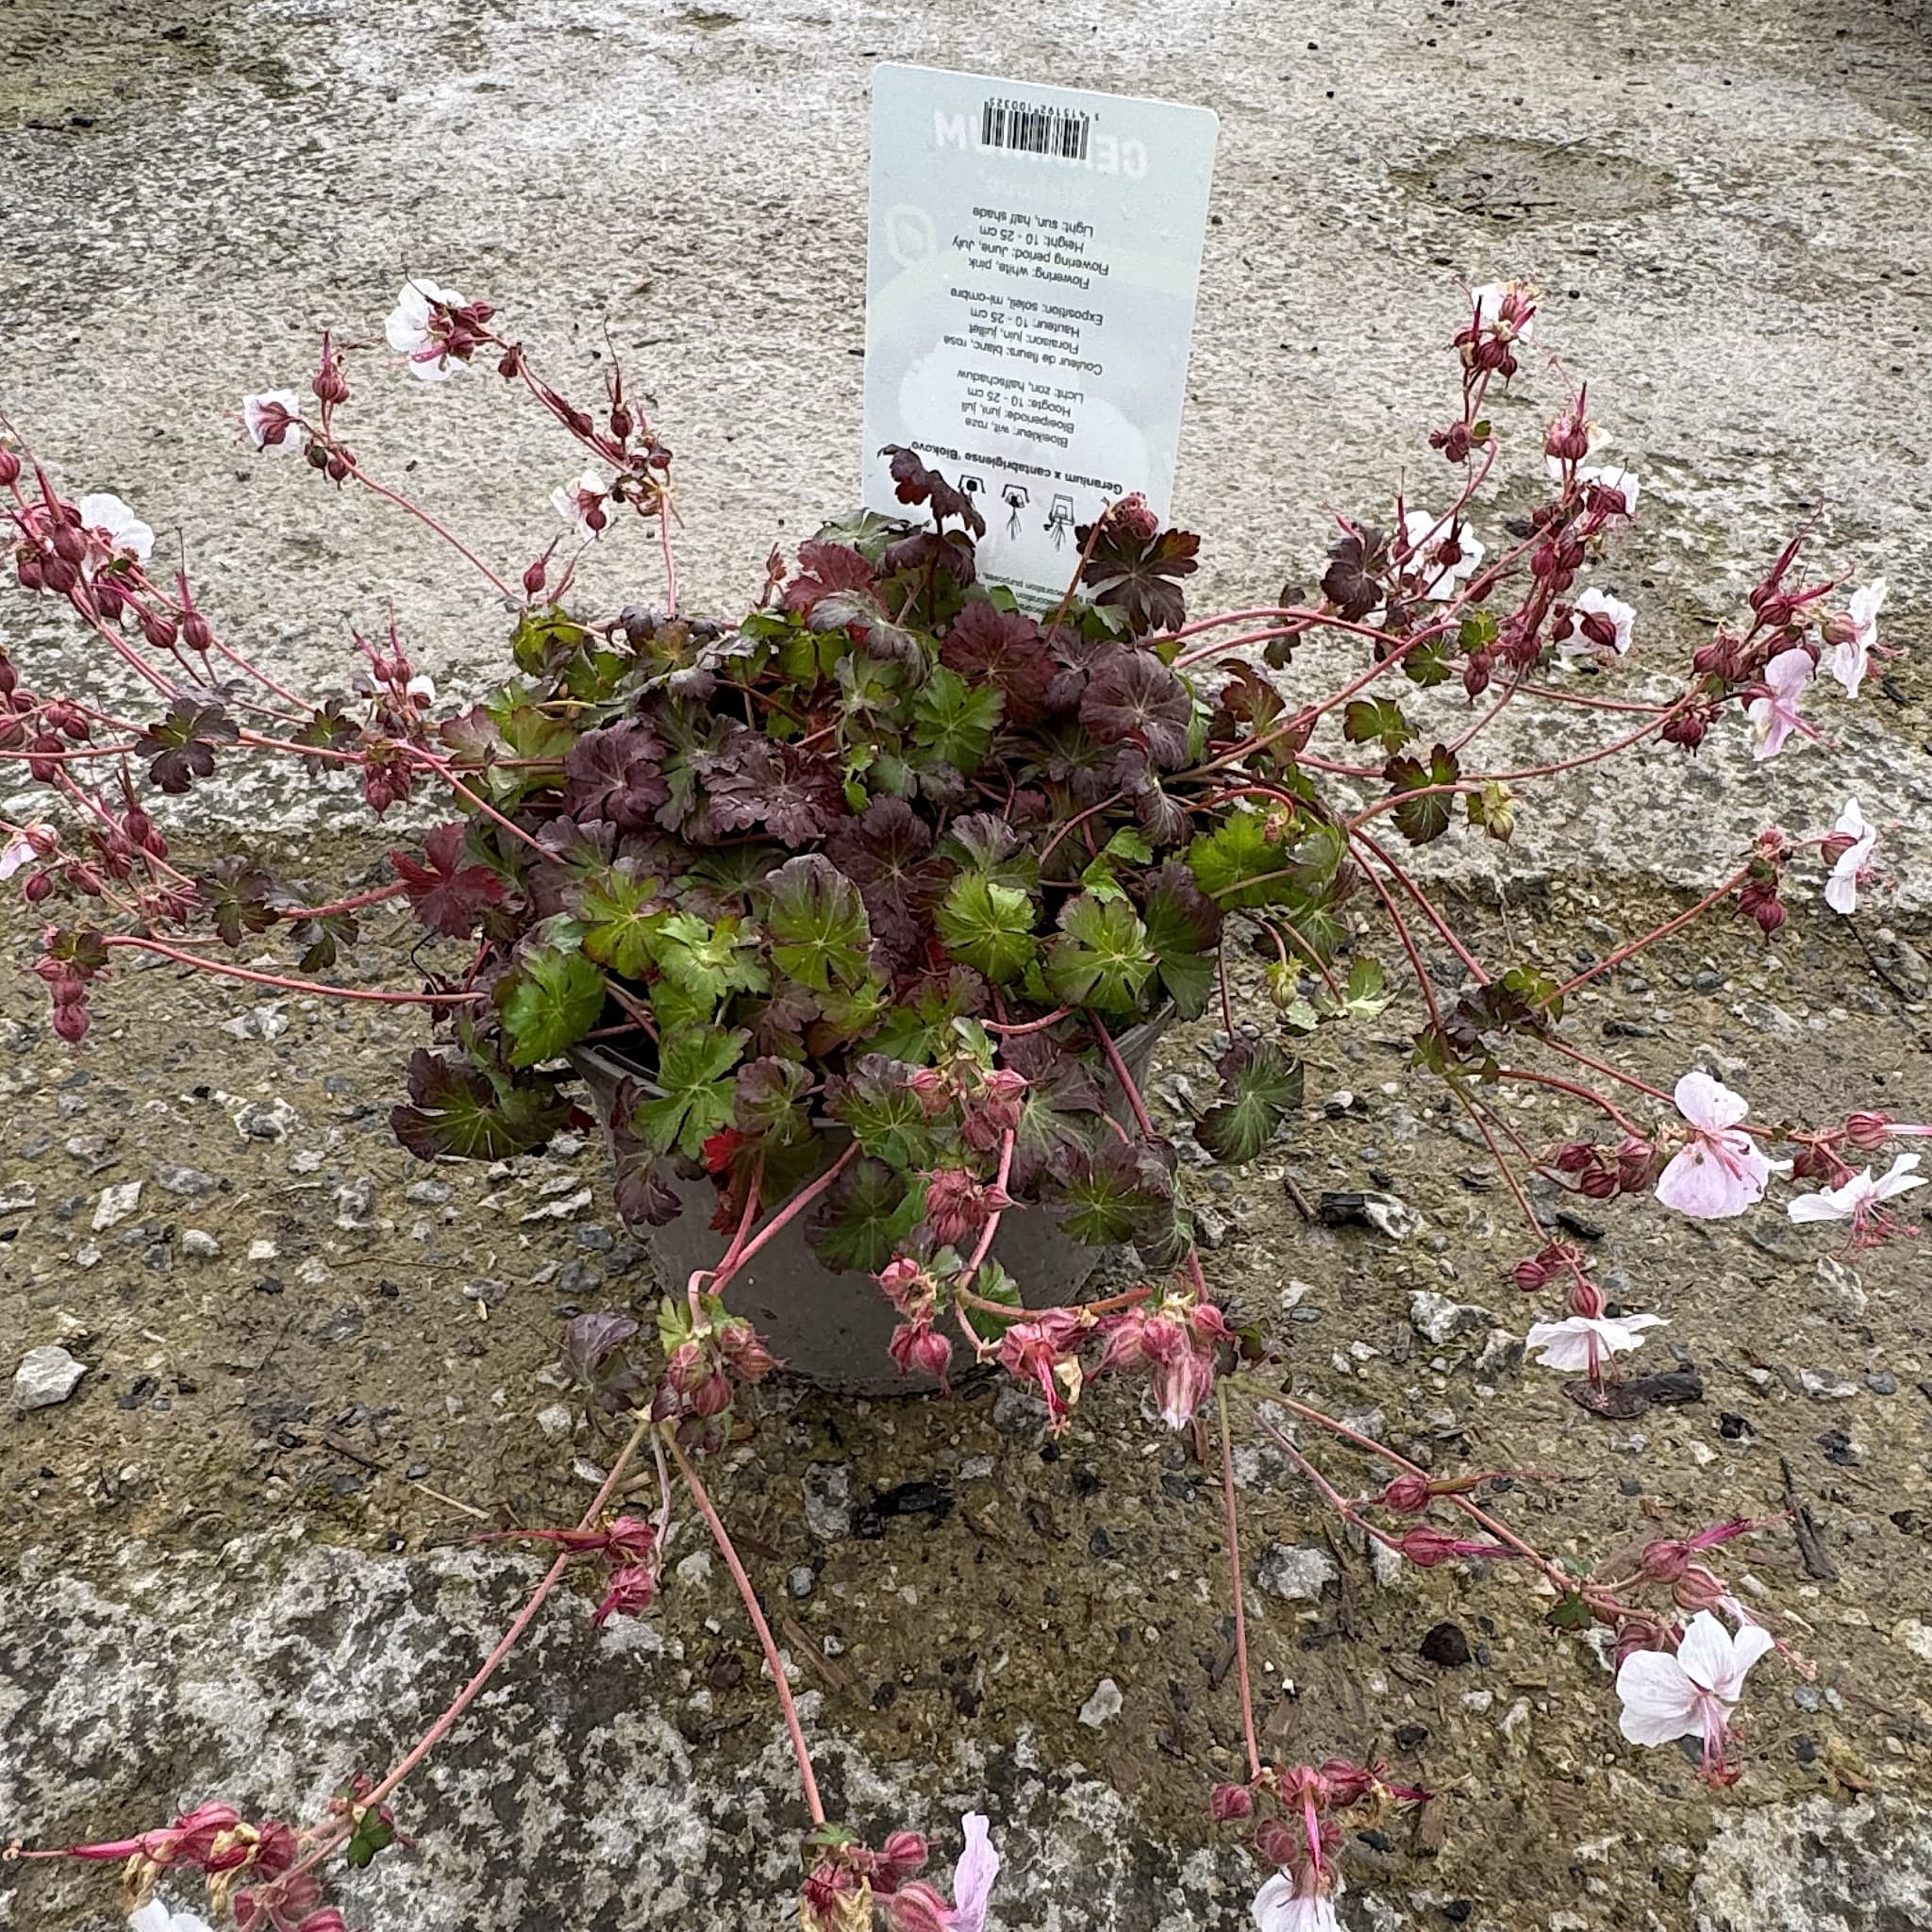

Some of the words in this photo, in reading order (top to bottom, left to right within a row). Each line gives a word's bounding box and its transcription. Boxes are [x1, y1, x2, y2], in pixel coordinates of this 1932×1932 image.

[973, 207, 1007, 223] shade
[1008, 213, 1031, 228] half
[1032, 214, 1058, 233] sun,
[1061, 221, 1093, 237] Light:
[979, 225, 997, 240] cm
[997, 226, 1017, 242] 25
[1025, 233, 1039, 246] 10
[952, 235, 977, 253] July
[976, 240, 1008, 258] June,
[1042, 232, 1084, 255] Height:
[1011, 247, 1051, 263] period:
[968, 257, 992, 272] pink
[995, 259, 1029, 277] white,
[1054, 252, 1108, 275] Flowering
[950, 288, 1004, 307] mi-ombre
[1007, 296, 1039, 313] soleil,
[970, 306, 990, 322] cm
[989, 309, 1006, 325] 25
[1015, 315, 1028, 328] 10
[1041, 304, 1104, 326] Exposition:
[969, 324, 999, 340] juillet
[998, 325, 1024, 343] juin,
[943, 335, 967, 347] rose
[971, 338, 1003, 358] blanc,
[1025, 334, 1079, 355] Floraison:
[1006, 346, 1039, 364] fleurs:
[1041, 354, 1057, 366] de
[1058, 355, 1103, 375] Couleur
[957, 370, 1024, 393] halfschaduw
[1028, 381, 1051, 395] zon,
[967, 387, 984, 398] cm
[986, 391, 1001, 403] 25
[1054, 389, 1084, 405] Licht:
[961, 402, 977, 416] juli
[1011, 394, 1024, 408] 10
[1026, 399, 1071, 418] Hoogte:
[979, 403, 1002, 419] juni,
[965, 417, 989, 429] roze
[991, 421, 1009, 435] wit,
[964, 455, 1051, 476] cantabrigiense
[1054, 468, 1062, 480] x
[1065, 473, 1123, 495] Geranium
